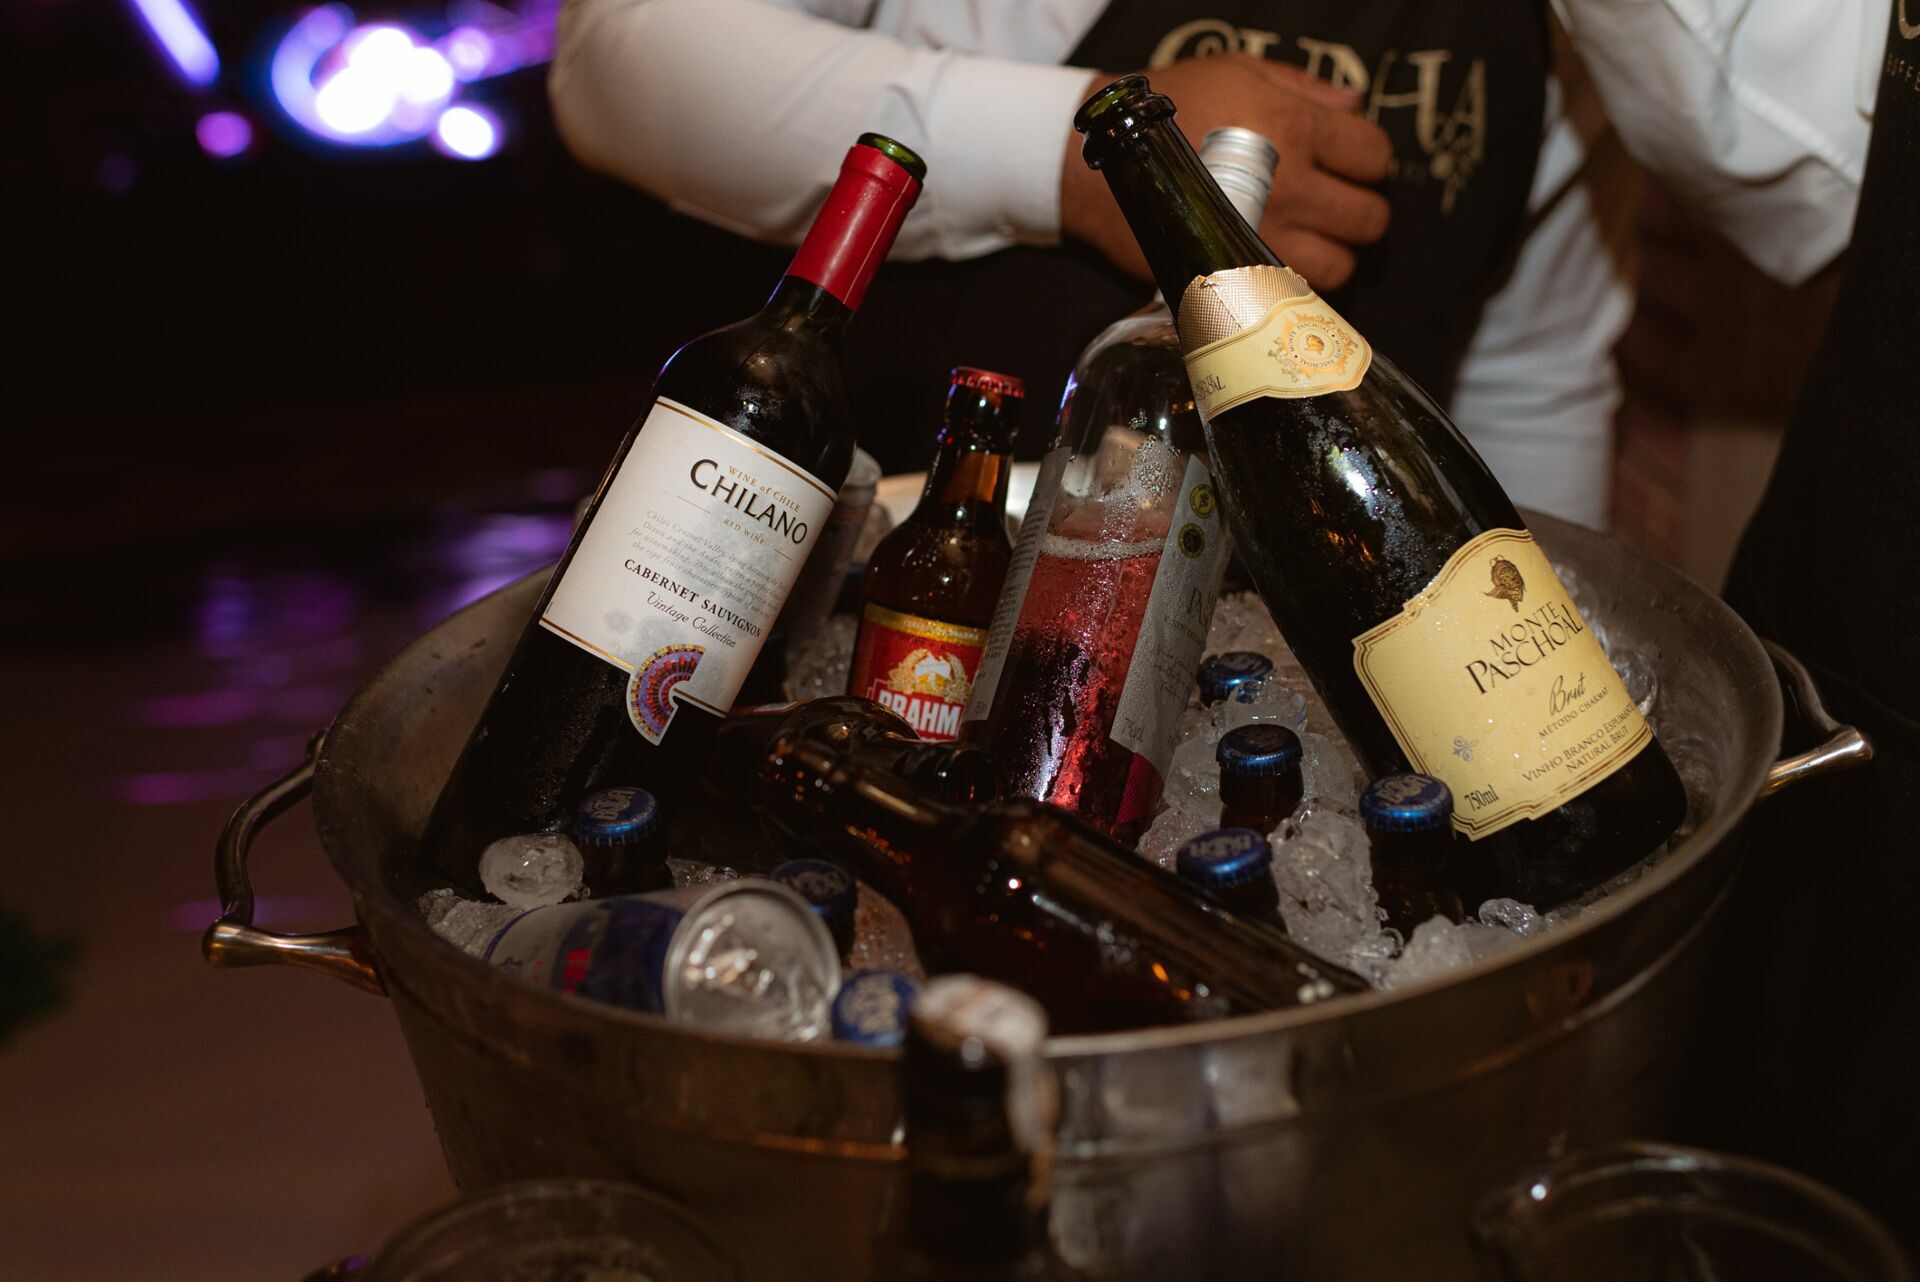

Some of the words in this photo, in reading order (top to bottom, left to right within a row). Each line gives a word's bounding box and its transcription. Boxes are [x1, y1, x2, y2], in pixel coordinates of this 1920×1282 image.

[690, 458, 808, 545] CHILANO
[729, 465, 758, 487] WINE
[760, 486, 772, 495] of
[773, 491, 801, 513] CHILE
[723, 518, 741, 532] RED
[744, 528, 765, 545] WINE
[624, 558, 699, 603] CABERNET
[701, 599, 762, 638] SAUVIGNON
[646, 591, 690, 623] Vintage
[692, 616, 737, 648] Collection
[1465, 604, 1583, 694] PASCHOAL
[1490, 601, 1560, 656] MONTE
[878, 690, 961, 736] BRAHM
[1549, 671, 1586, 717] Brut
[1578, 686, 1609, 714] CHARMAT
[1522, 756, 1564, 782] VINHO
[1563, 728, 1605, 760] BRANCO
[1566, 740, 1611, 773] NATURAL
[1610, 725, 1630, 744] BRUT
[1464, 784, 1499, 812] 750ml
